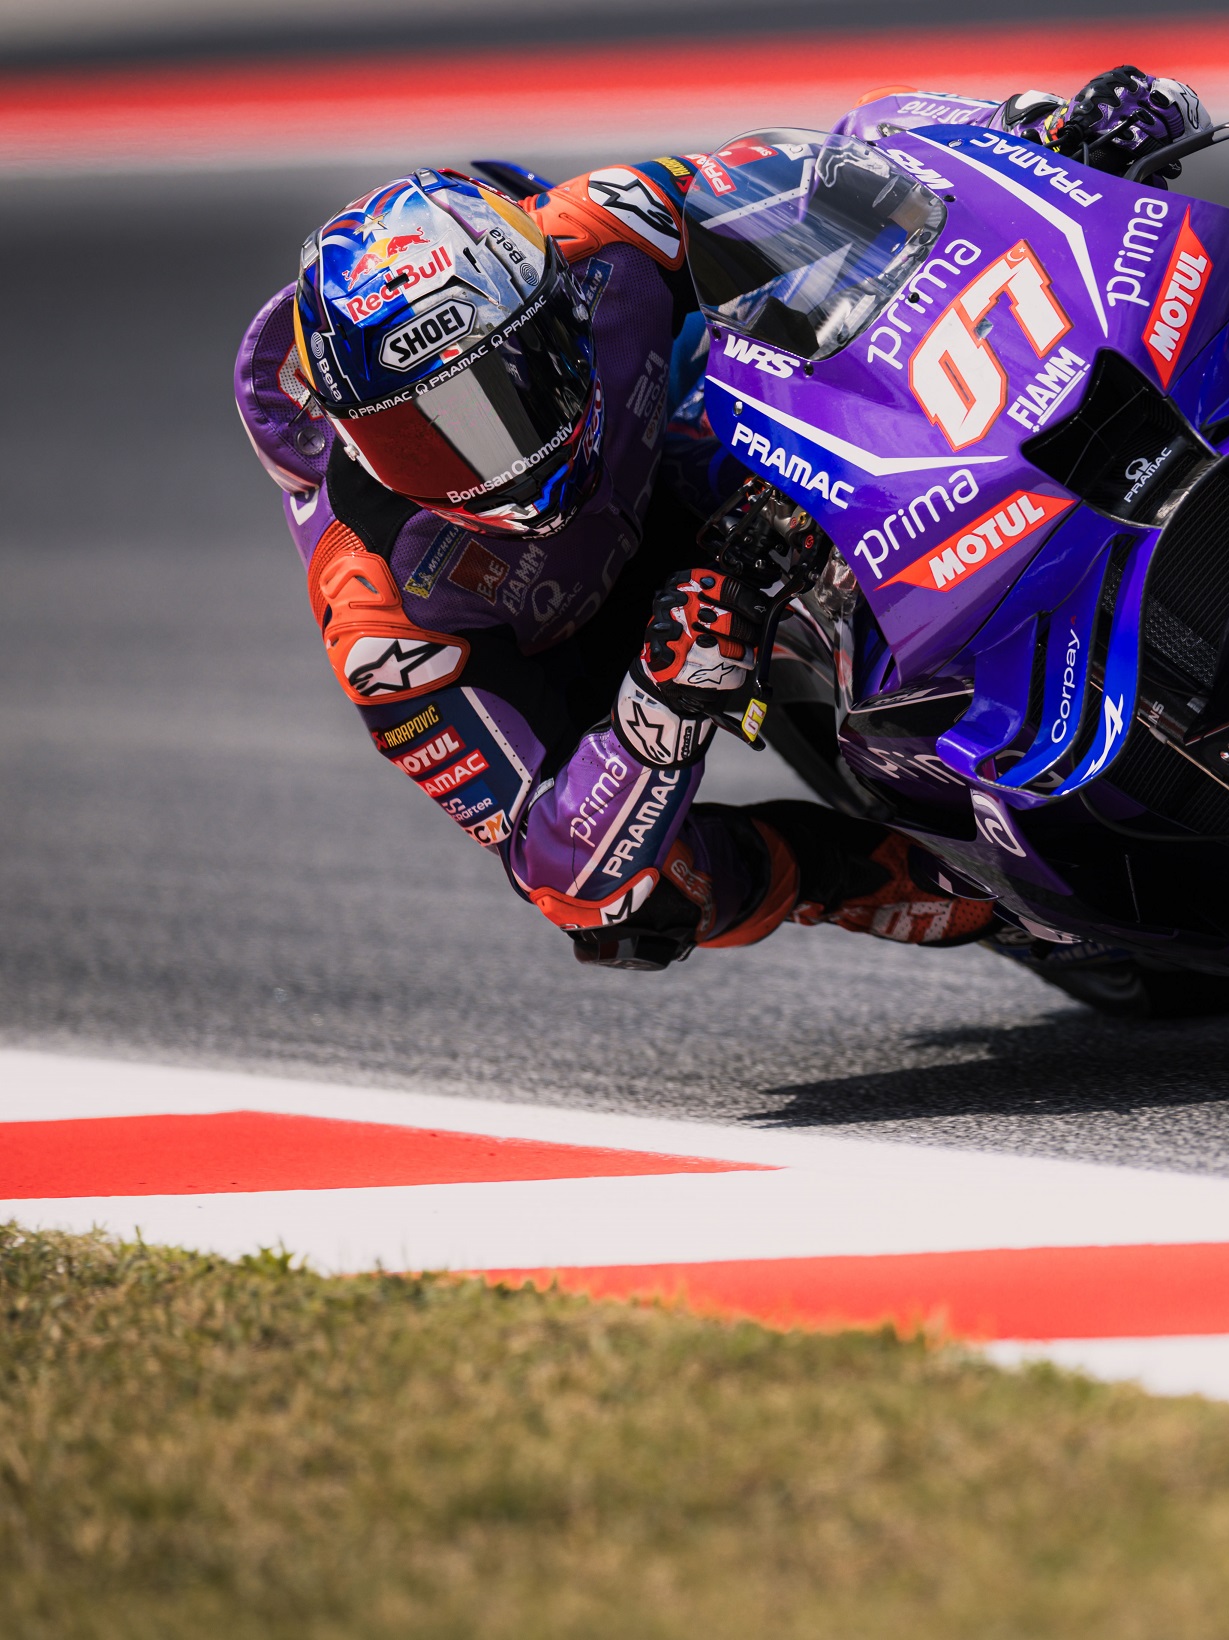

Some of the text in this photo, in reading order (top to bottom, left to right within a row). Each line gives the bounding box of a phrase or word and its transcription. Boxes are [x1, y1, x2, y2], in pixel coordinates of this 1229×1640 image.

[897, 100, 982, 126] prima
[886, 148, 955, 190] WRS
[969, 132, 1103, 208] PRAMAC
[346, 246, 453, 323] Red Bull
[489, 228, 527, 265] Beta
[1106, 197, 1168, 307] prima
[389, 305, 466, 364] SHOEI
[867, 238, 982, 370] prima
[909, 240, 1073, 451] 07
[1148, 250, 1209, 362] MOTUL
[319, 357, 343, 401] Beta
[358, 294, 547, 417] PRAMAC PRAMAC PRAMAC
[722, 334, 801, 379] WRS
[1006, 345, 1087, 431] FIAMM
[446, 470, 514, 504] Borusan
[511, 421, 574, 476] Otomotiv
[731, 422, 855, 510] PRAMAC
[1123, 446, 1173, 503] PRAMAC
[853, 467, 980, 580] prima
[928, 495, 1045, 590] MOTUL
[743, 700, 766, 736] 07
[1050, 628, 1081, 745] Corpay
[424, 753, 486, 795] AMAC
[570, 757, 629, 848] prima
[602, 767, 681, 878] PRAMAC
